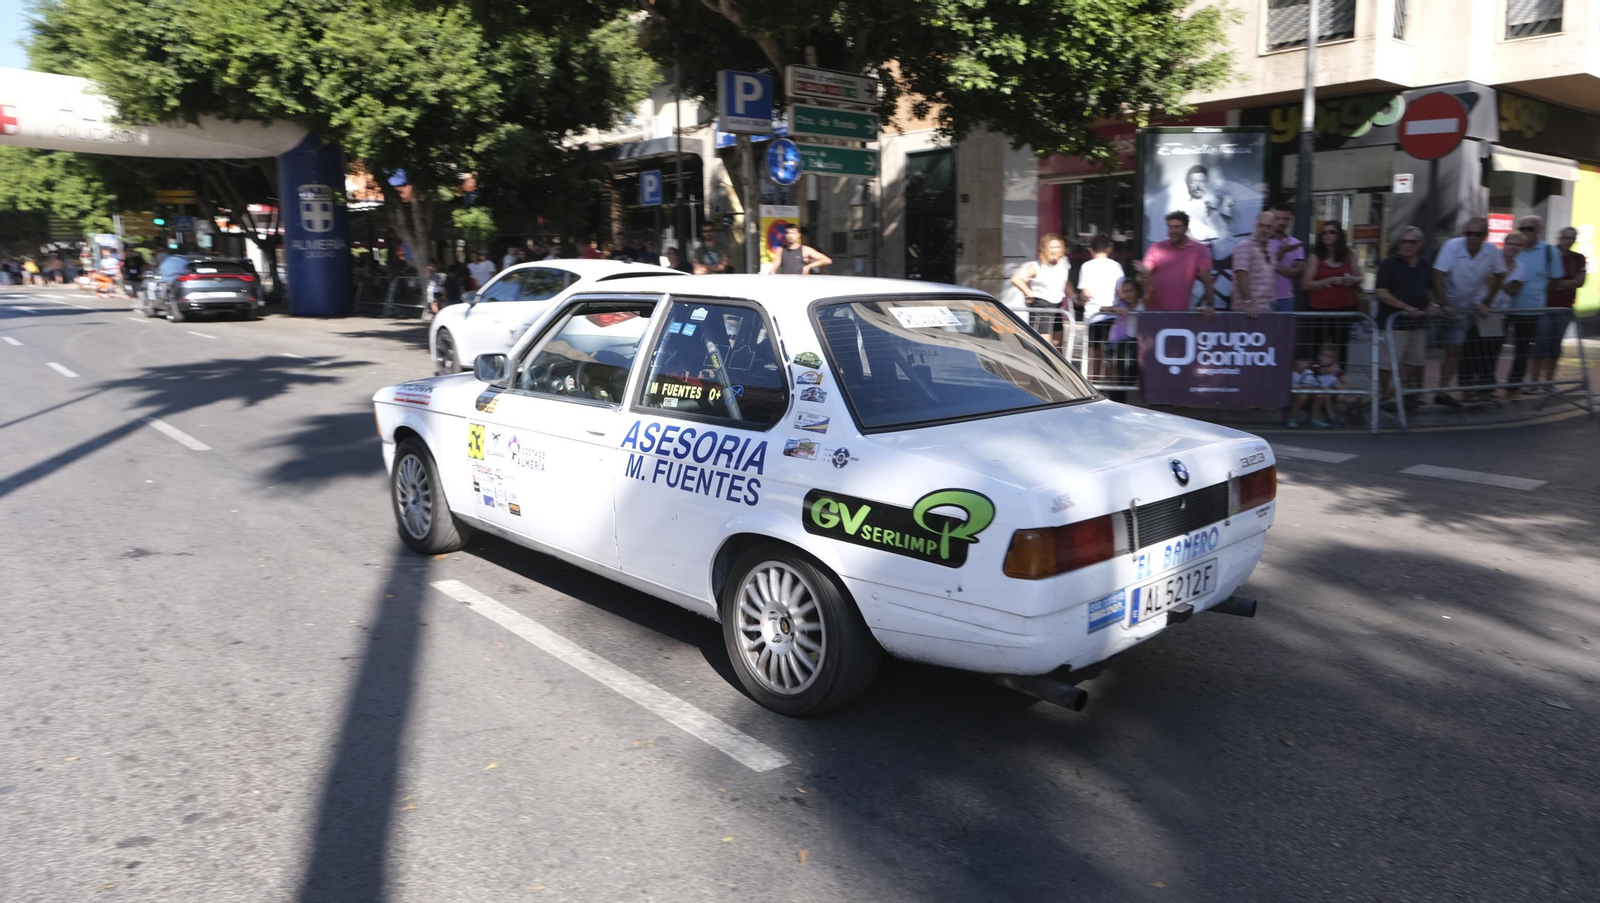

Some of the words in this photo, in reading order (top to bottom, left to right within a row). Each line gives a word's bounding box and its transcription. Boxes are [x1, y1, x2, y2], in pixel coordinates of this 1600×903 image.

[734, 75, 763, 114] P
[645, 174, 658, 202] P
[972, 305, 1018, 334] 53
[1196, 331, 1267, 351] grupo
[1196, 346, 1278, 366] control
[650, 382, 659, 394] M
[662, 383, 702, 399] FUENTES
[468, 423, 485, 460] 53
[621, 420, 768, 475] ASESORIA
[1240, 453, 1265, 468] 323
[625, 453, 645, 480] M.
[652, 459, 762, 506] FUENTES
[811, 498, 872, 535] GV
